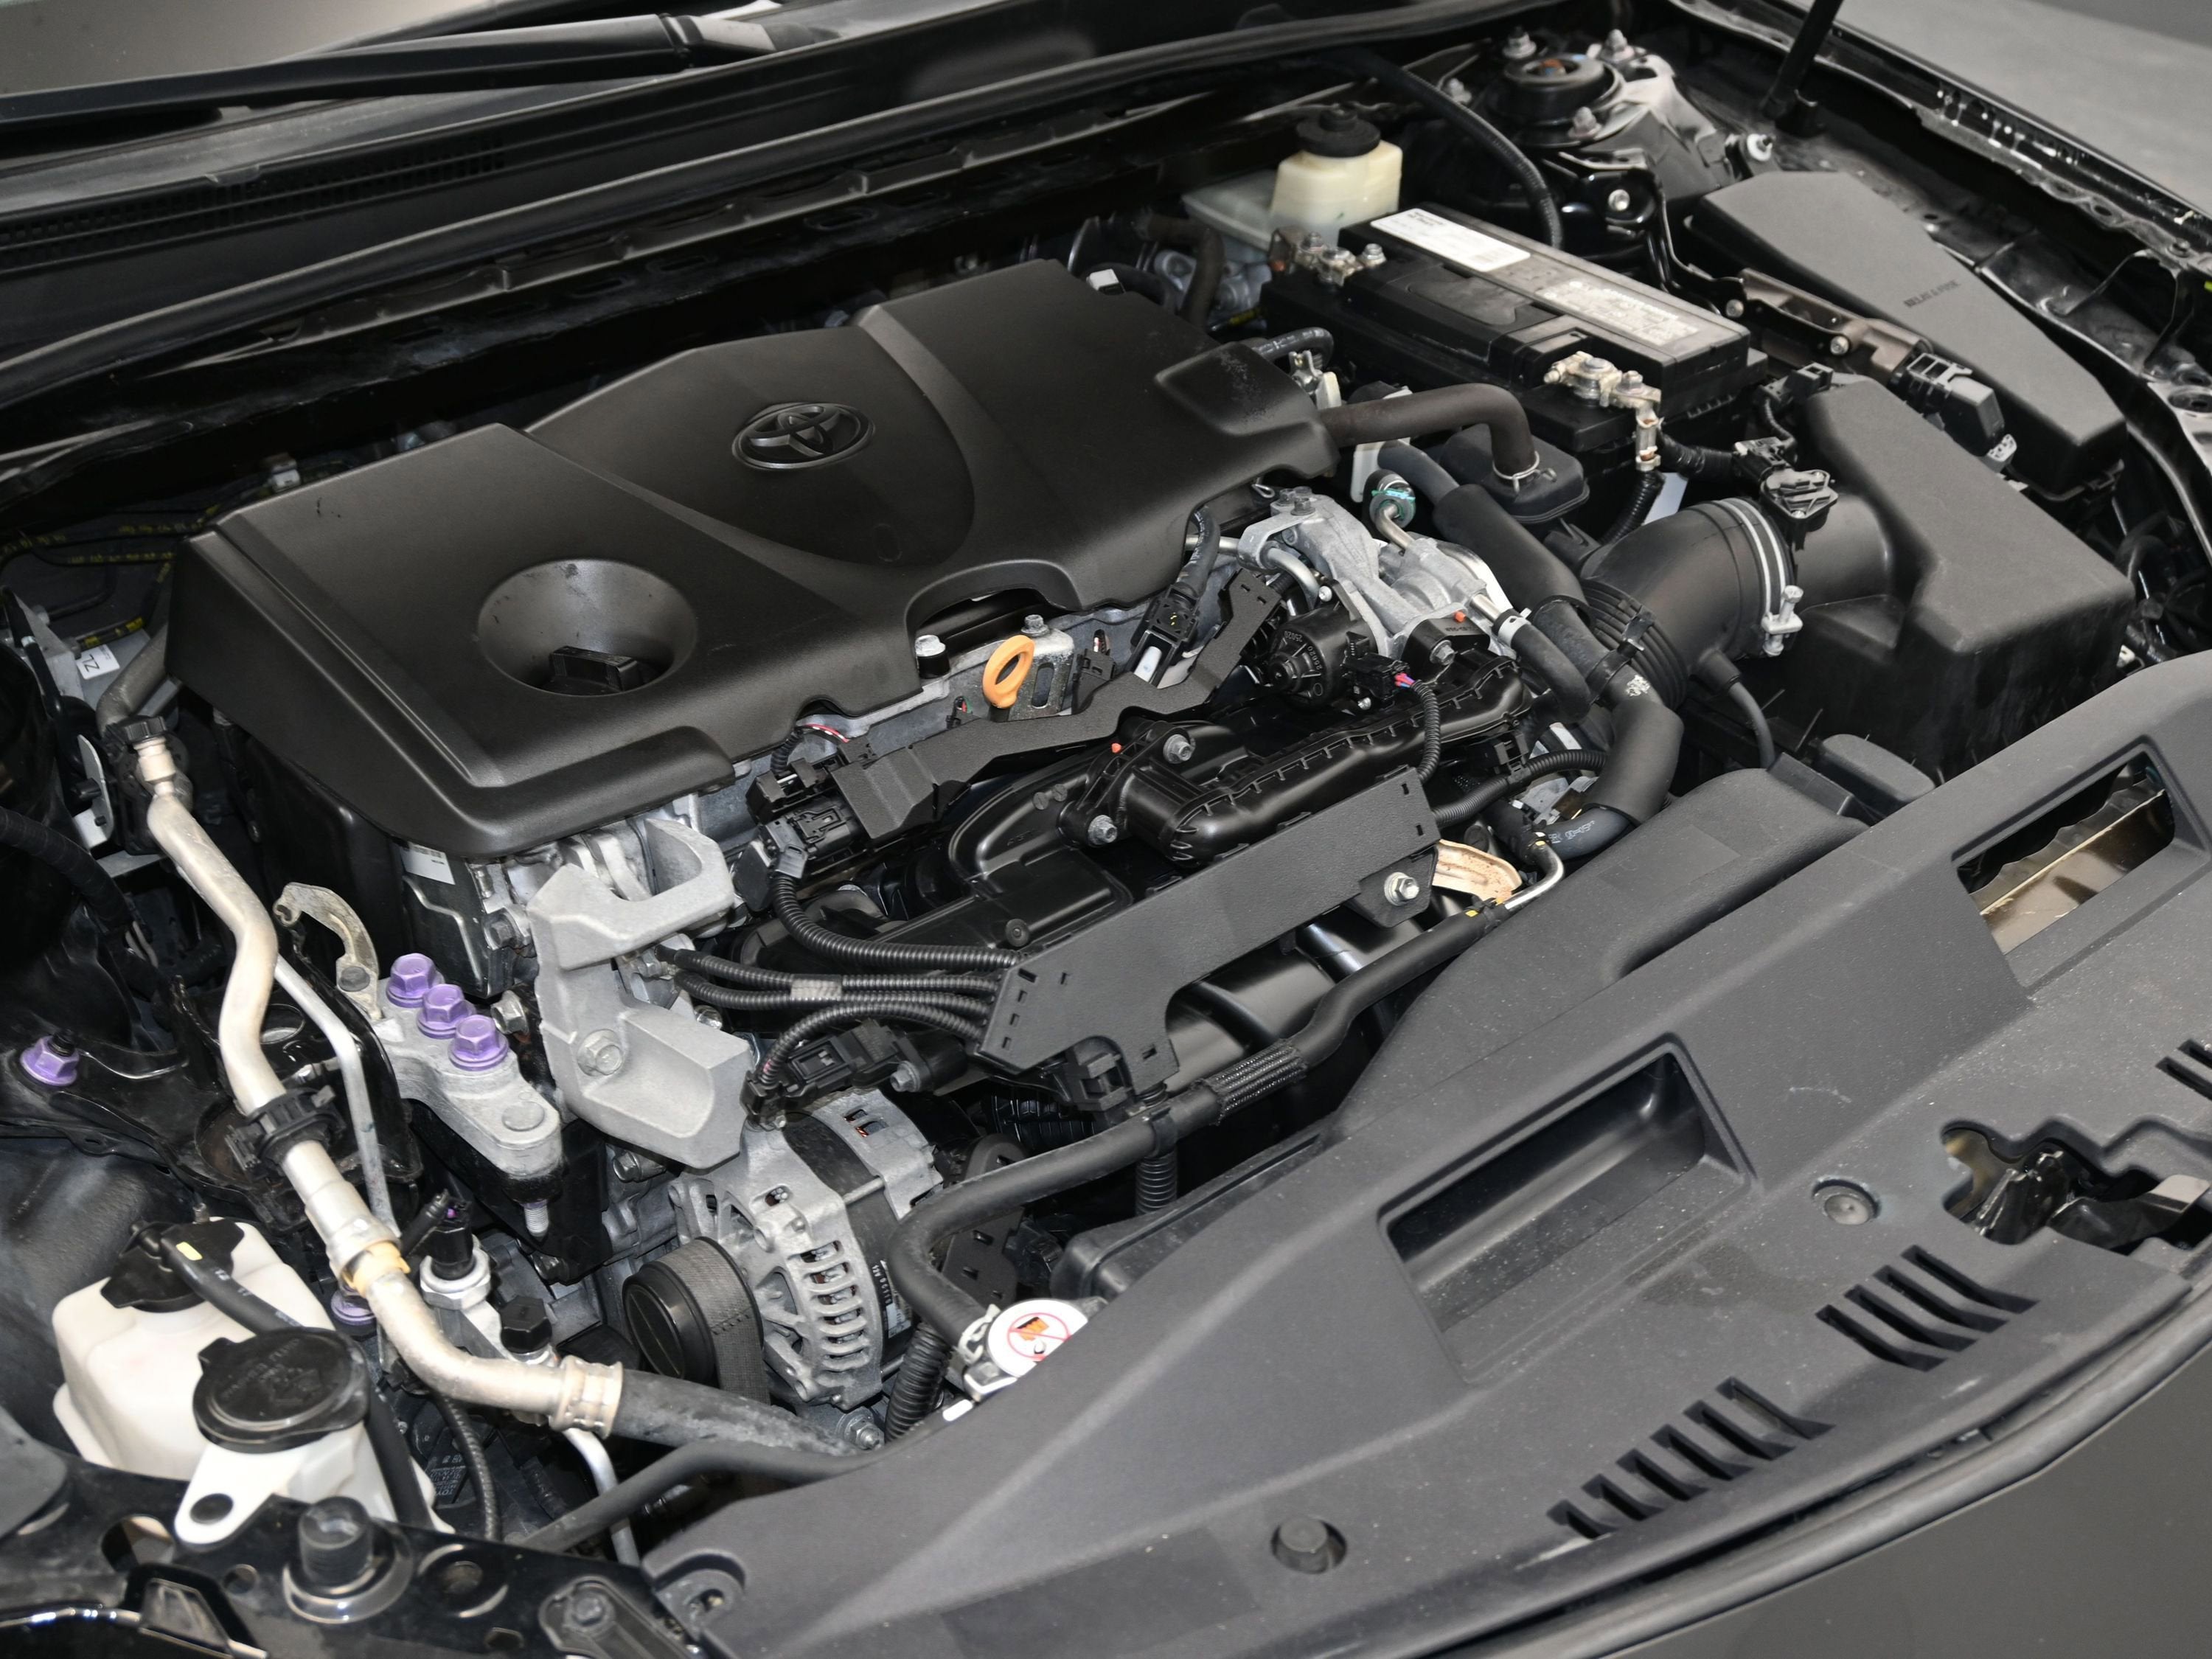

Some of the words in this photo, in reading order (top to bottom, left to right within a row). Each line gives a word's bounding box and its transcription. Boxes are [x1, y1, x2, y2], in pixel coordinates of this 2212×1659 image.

[1284, 630, 1303, 643] 25020
[82, 653, 100, 672] ZL
[436, 1488, 453, 1496] TOY
